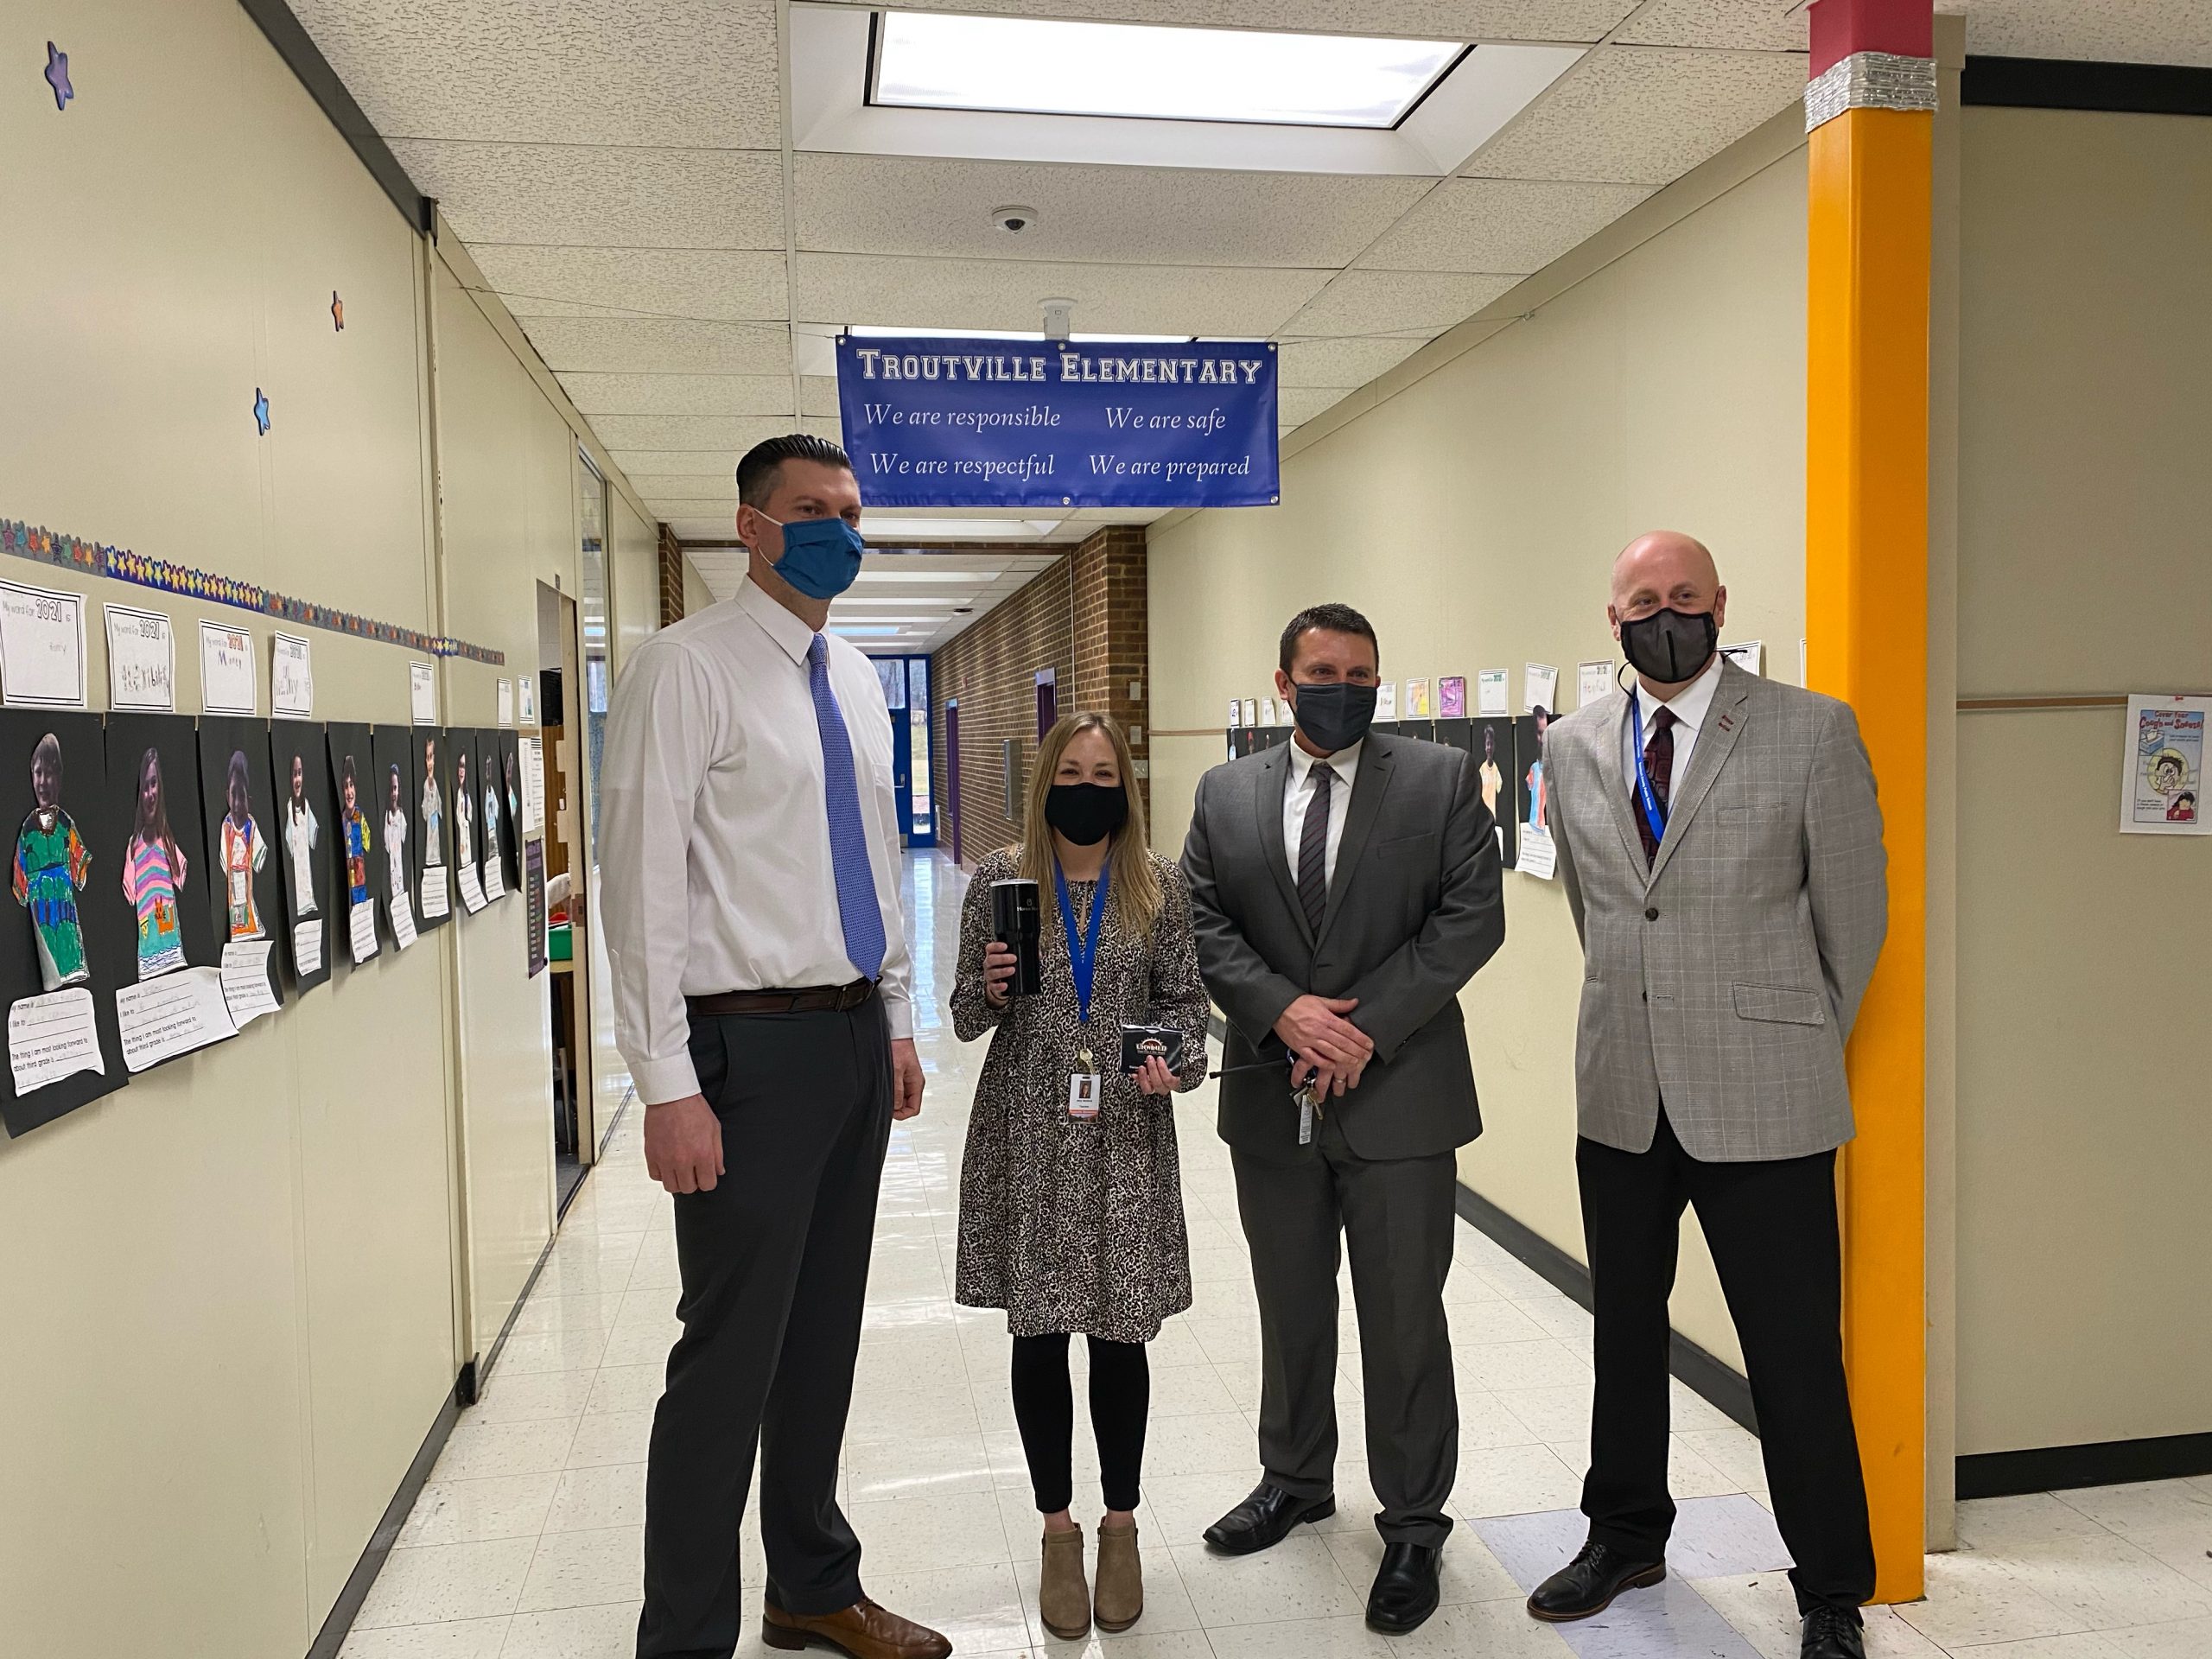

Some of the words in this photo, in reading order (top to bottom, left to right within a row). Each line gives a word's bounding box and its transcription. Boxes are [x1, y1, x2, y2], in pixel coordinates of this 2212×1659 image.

[856, 348, 1047, 381] TROUTVILLE
[1059, 353, 1262, 385] ELEMENTARY
[864, 404, 903, 427] We
[909, 410, 942, 426] are
[947, 405, 1061, 433] responsible
[1105, 407, 1144, 429] We
[1149, 414, 1182, 429] are
[1187, 407, 1226, 436] safe
[871, 453, 910, 475] We
[916, 460, 948, 474] are
[953, 454, 1055, 481] respectful
[1090, 454, 1128, 475] We
[1131, 460, 1161, 475] are
[1166, 455, 1250, 482] prepared
[35, 598, 62, 623] 2021
[139, 620, 160, 640] 2021
[2139, 716, 2164, 728] Cough
[131, 1034, 143, 1044] thing
[162, 1022, 176, 1033] looking
[176, 1017, 193, 1028] forward
[20, 1050, 31, 1059] thing
[52, 1042, 67, 1052] looking
[67, 1039, 84, 1048] forward
[126, 1046, 139, 1056] about
[139, 1042, 149, 1052] third
[149, 1039, 162, 1049] grade
[13, 1064, 26, 1072] about
[26, 1061, 37, 1070] third
[37, 1058, 51, 1068] grade
